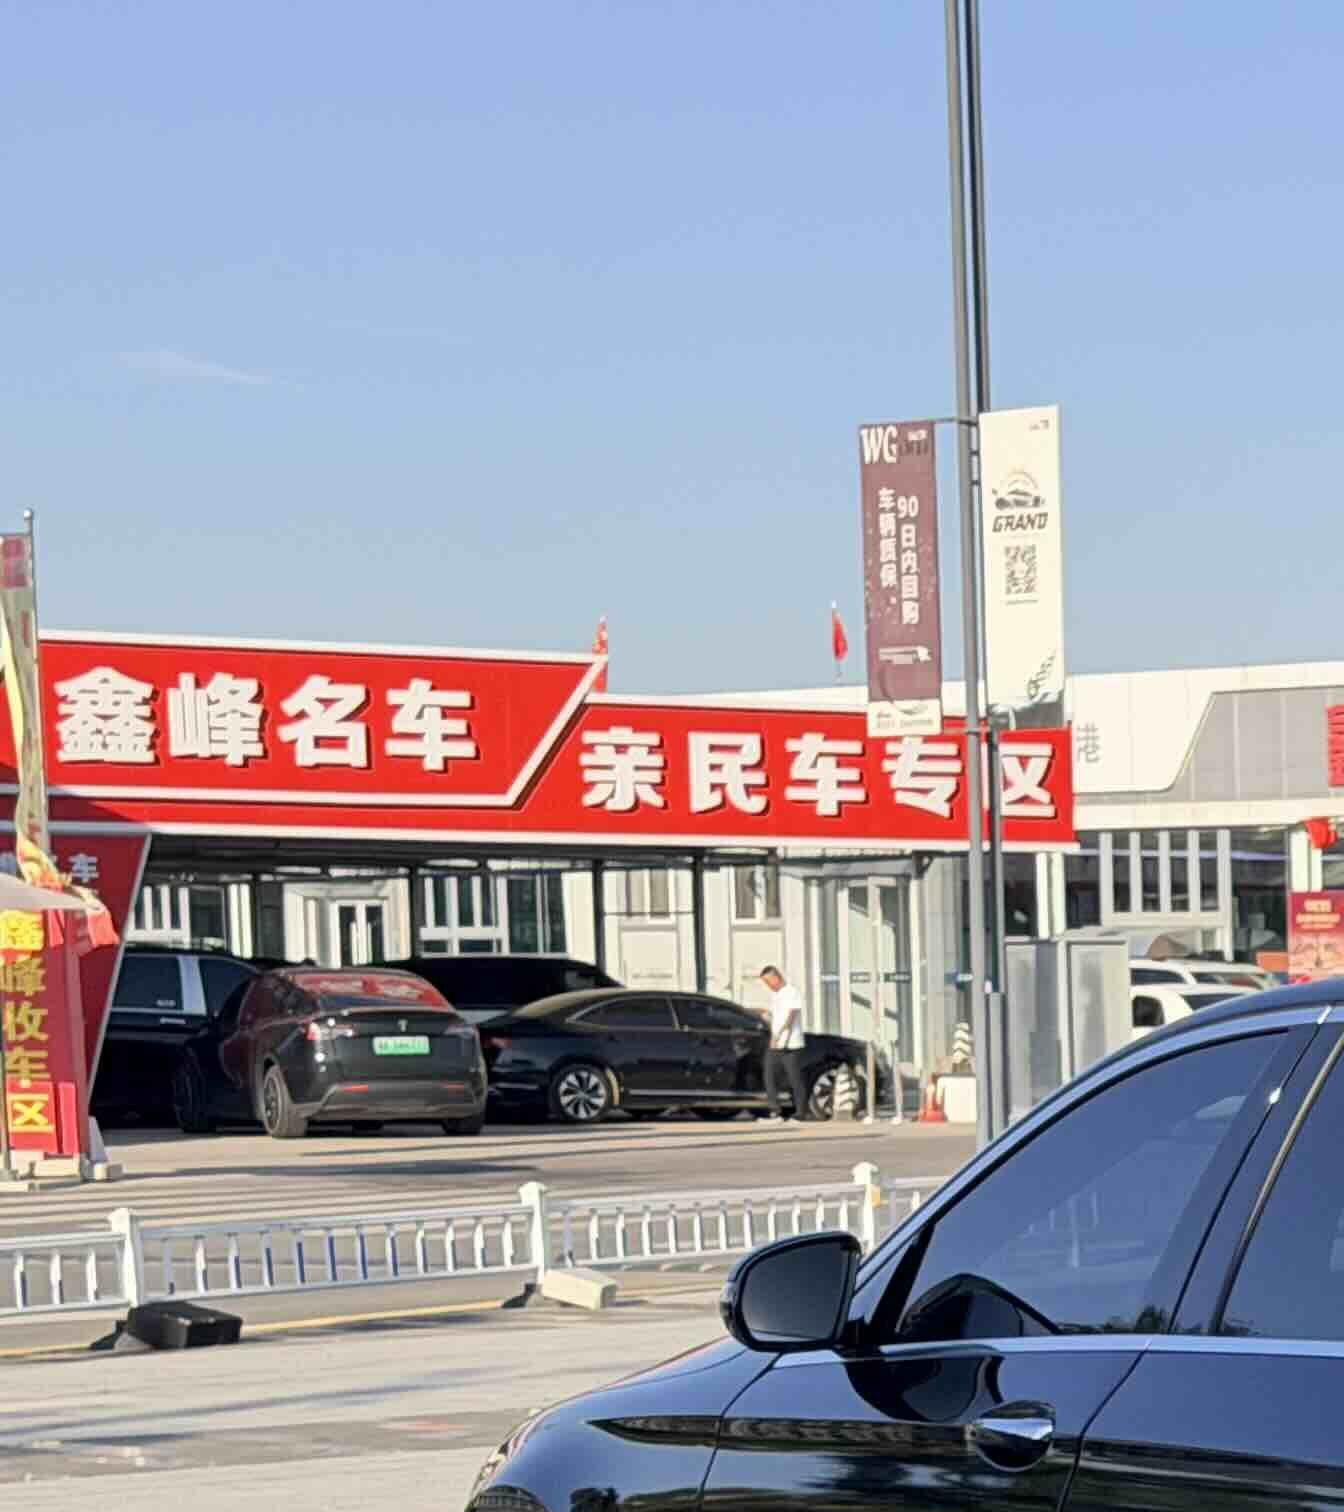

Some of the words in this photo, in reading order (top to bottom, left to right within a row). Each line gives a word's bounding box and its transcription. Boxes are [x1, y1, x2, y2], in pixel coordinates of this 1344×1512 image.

[861, 424, 898, 465] WG
[992, 511, 1049, 534] GRAND
[54, 666, 476, 771] 鑫峰名车
[578, 725, 1056, 820] 亲民车专区
